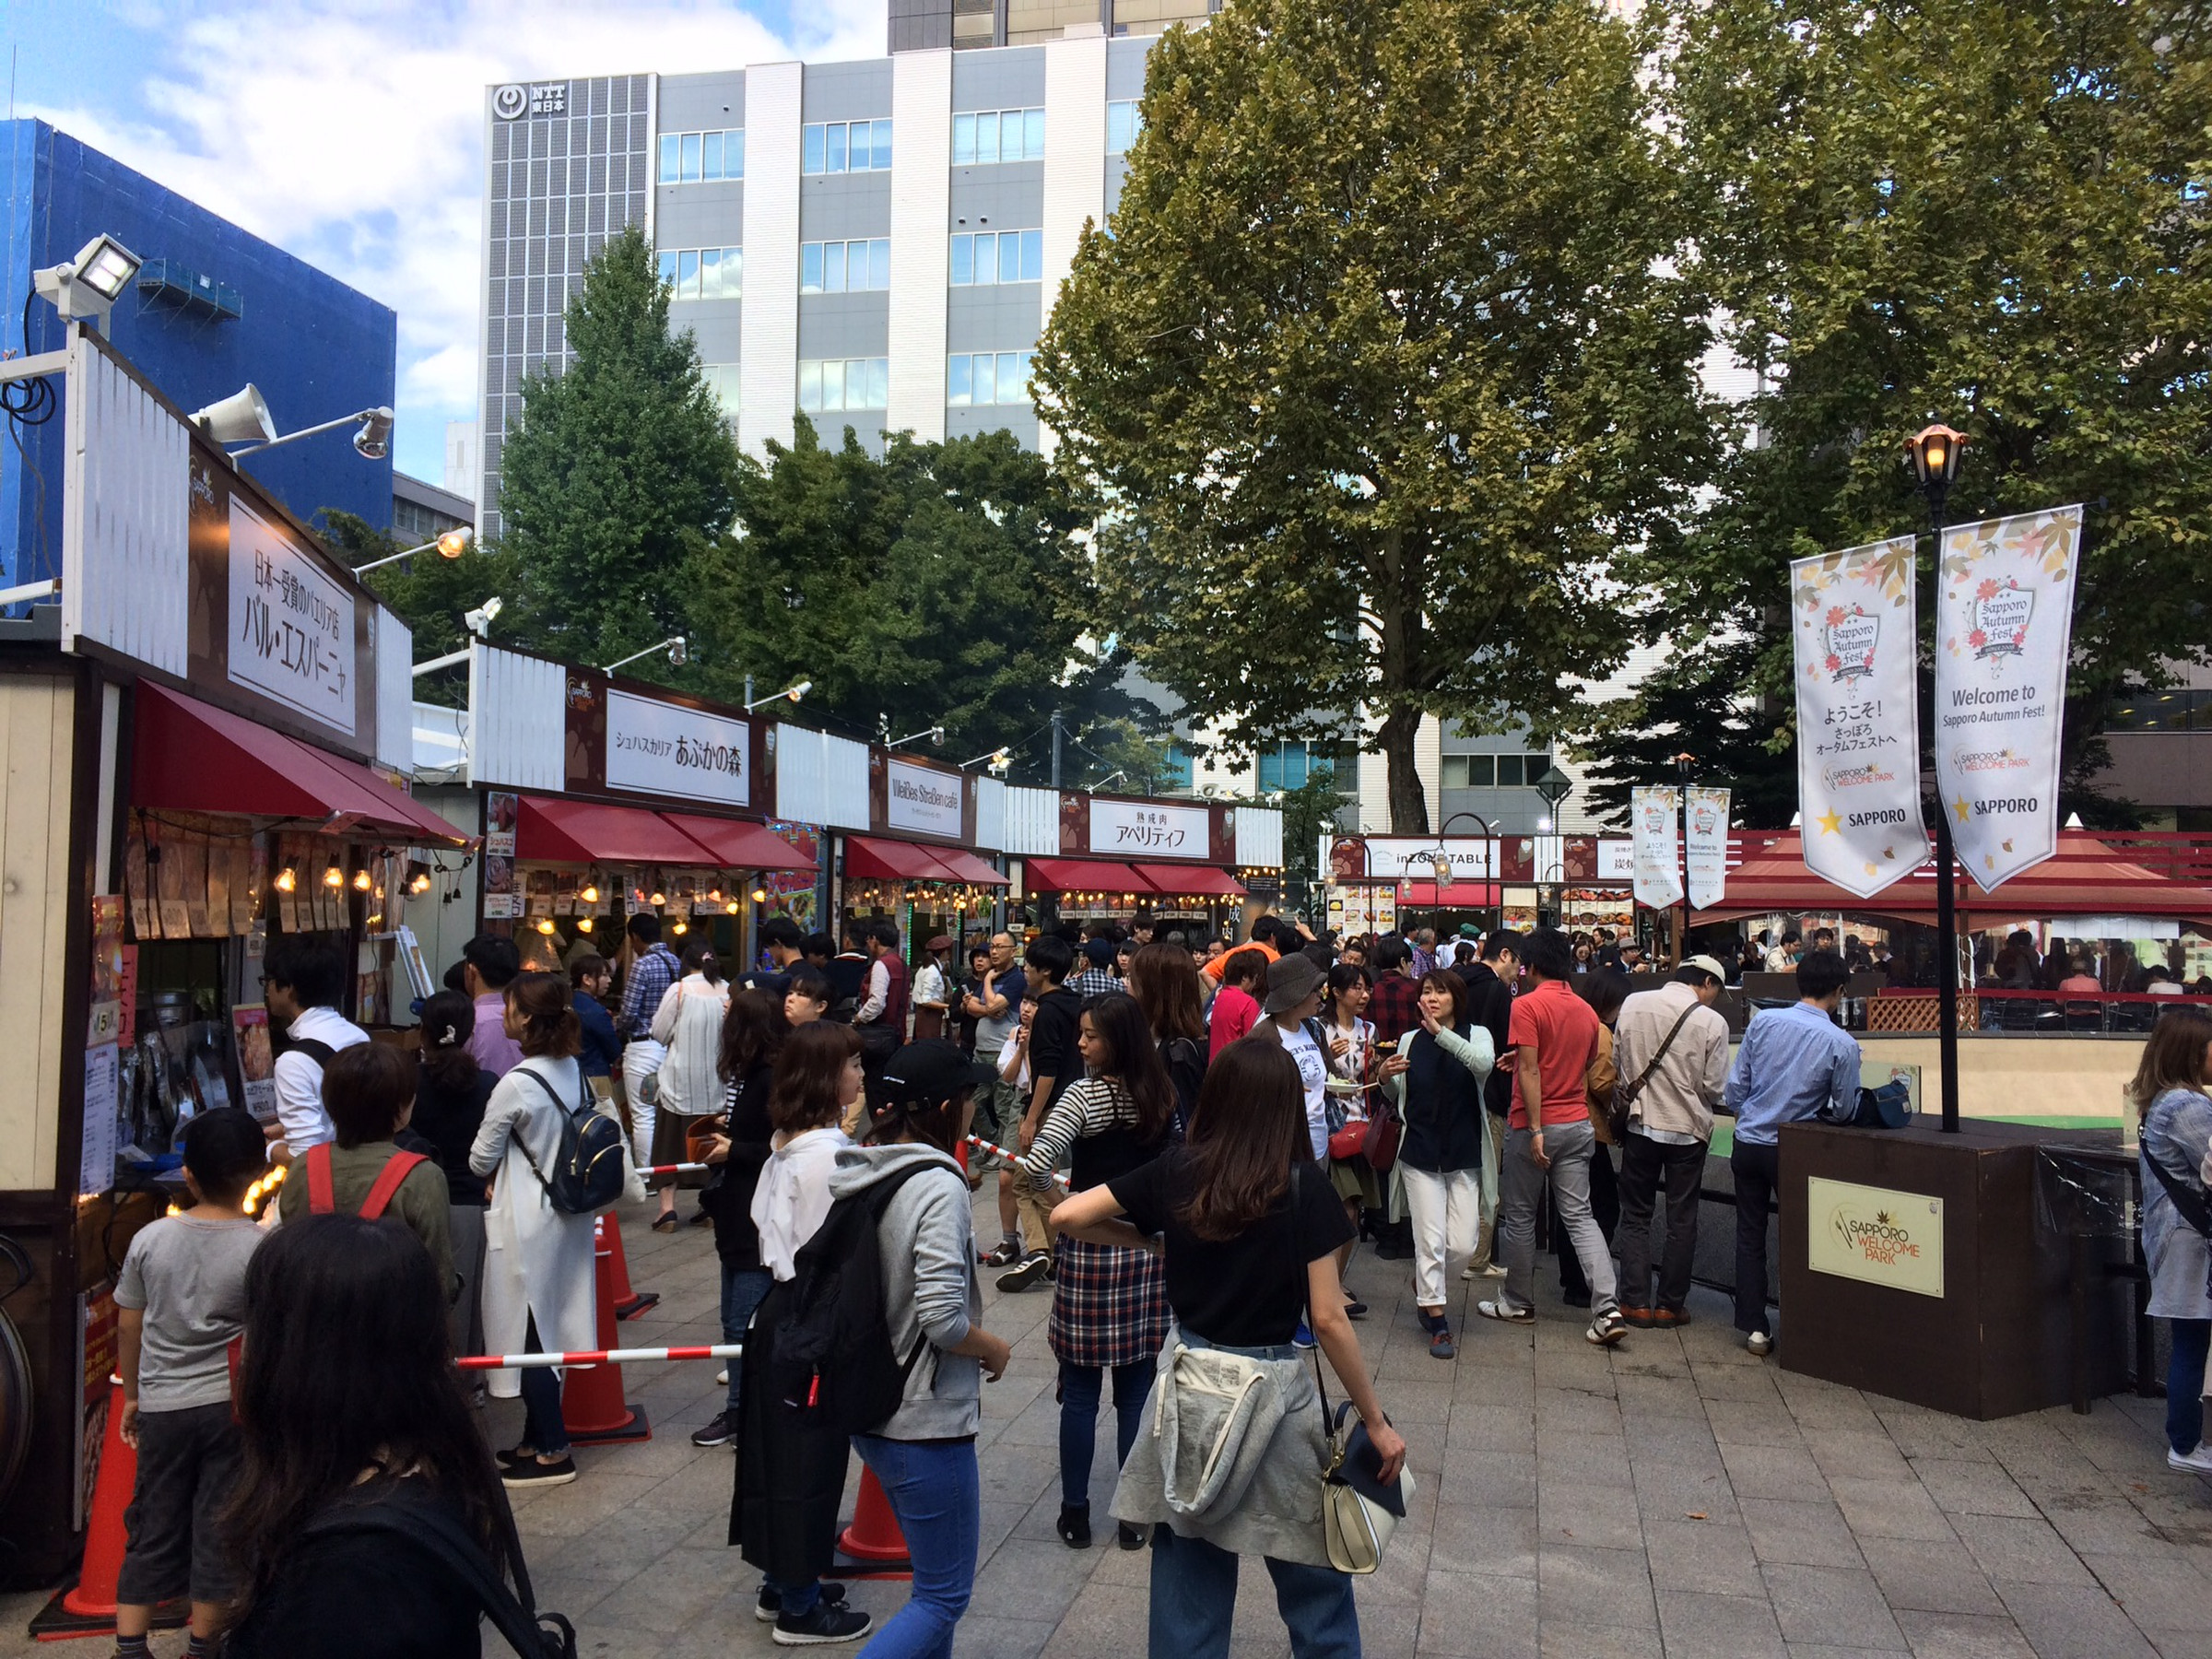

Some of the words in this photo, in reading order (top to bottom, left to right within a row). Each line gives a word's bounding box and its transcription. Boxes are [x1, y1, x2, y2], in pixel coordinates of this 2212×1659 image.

[532, 85, 566, 100] NTT
[532, 99, 565, 113] 東日本
[255, 549, 339, 641] 日本一受賞のパエリア店
[1982, 600, 2027, 615] Sapporo
[1983, 615, 2025, 628] Autumn
[1833, 625, 1874, 641] Sapporo
[242, 594, 346, 703] バル・エスパーニャ
[1834, 639, 1873, 653] Autumn
[1952, 687, 2019, 706] Welcome
[2022, 685, 2036, 700] to
[1943, 713, 1977, 729] Sapporo
[1979, 710, 2020, 723] Autumn
[2022, 704, 2045, 718] Fest!
[1835, 724, 1873, 739] さっぽろ
[617, 732, 673, 757] シュハスカリア
[1817, 735, 1898, 756] オータムフェストへ
[1961, 752, 1999, 764] SAPPORO
[1965, 759, 2006, 771] WELCOME
[2008, 758, 2030, 768] PARK
[1832, 768, 1866, 780] SAPPORO
[1837, 775, 1874, 787] WELCOME
[1875, 772, 1895, 782] PARK
[1974, 797, 2038, 816] SAPPORO
[1136, 812, 1168, 825] 熟成肉
[1849, 808, 1906, 827] SAPPORO
[1115, 826, 1185, 848] アペリティフ
[1450, 853, 1492, 865] TABLE
[1850, 1220, 1909, 1242] SAPPORO
[1857, 1232, 1920, 1258] WELCOME
[1865, 1248, 1896, 1265] PARK
